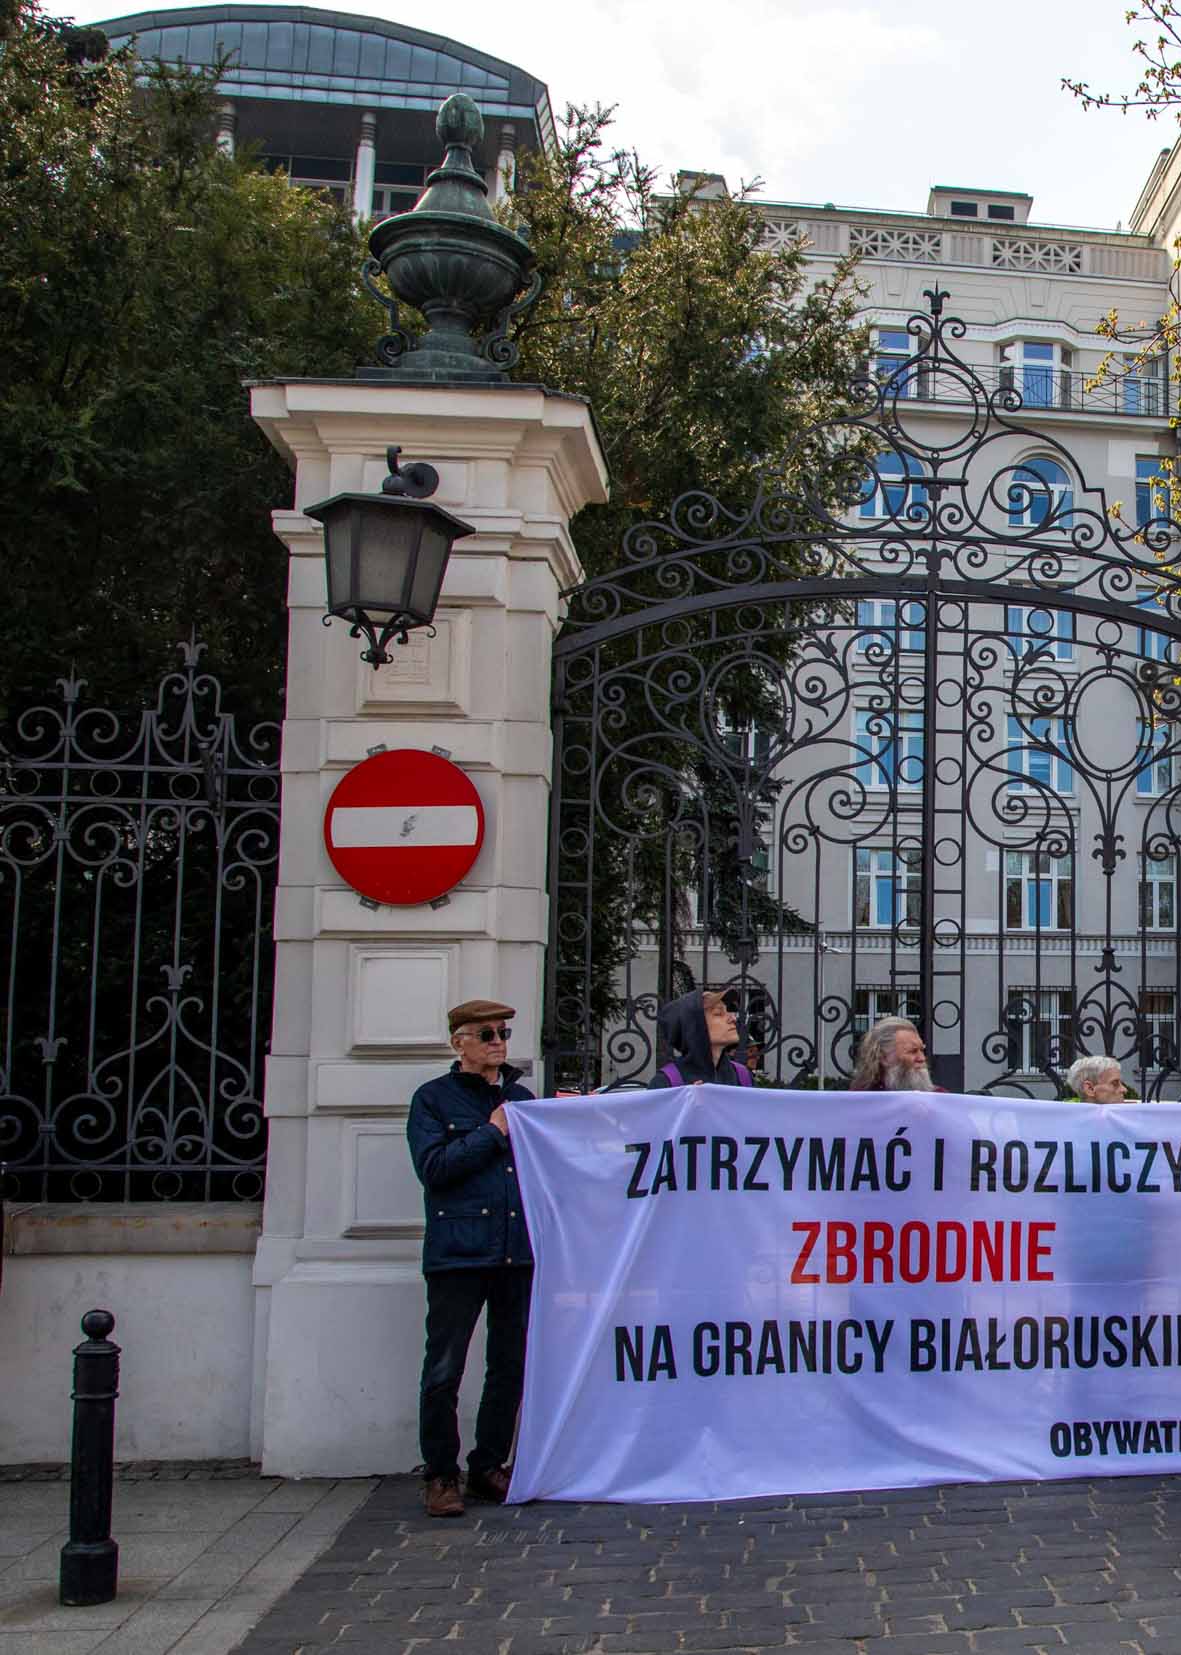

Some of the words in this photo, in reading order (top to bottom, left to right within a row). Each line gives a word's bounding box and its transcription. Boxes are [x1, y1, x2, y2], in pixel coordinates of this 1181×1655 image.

[624, 1127, 912, 1199] ZATRZYMAĆ
[933, 1138, 945, 1191] I
[791, 1220, 1056, 1284] ZBRODNIE
[614, 1325, 677, 1382] NA
[692, 1319, 894, 1377] GRANICY
